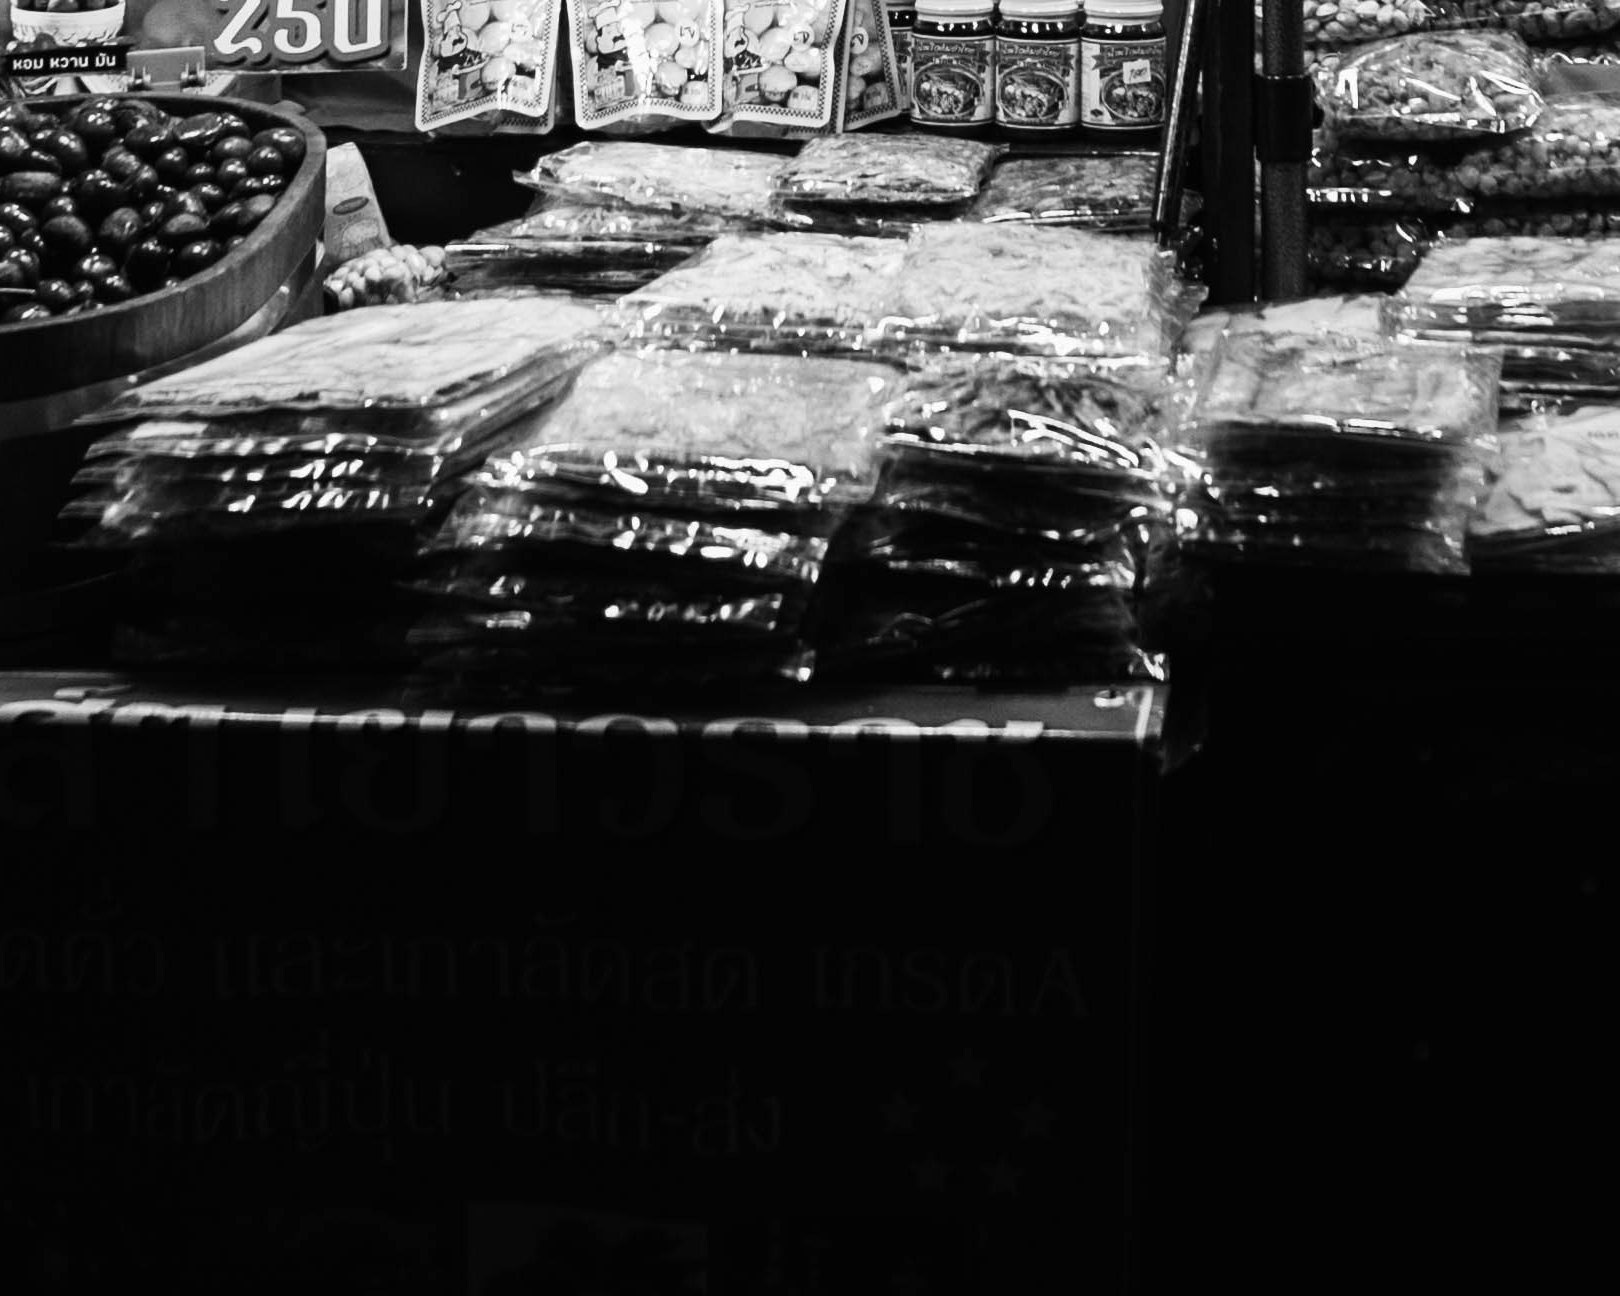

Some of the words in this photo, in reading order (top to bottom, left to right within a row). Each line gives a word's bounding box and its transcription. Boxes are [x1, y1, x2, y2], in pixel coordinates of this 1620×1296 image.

[11, 54, 45, 71] หอม
[48, 52, 90, 70] หวาน
[94, 48, 117, 69] มัน
